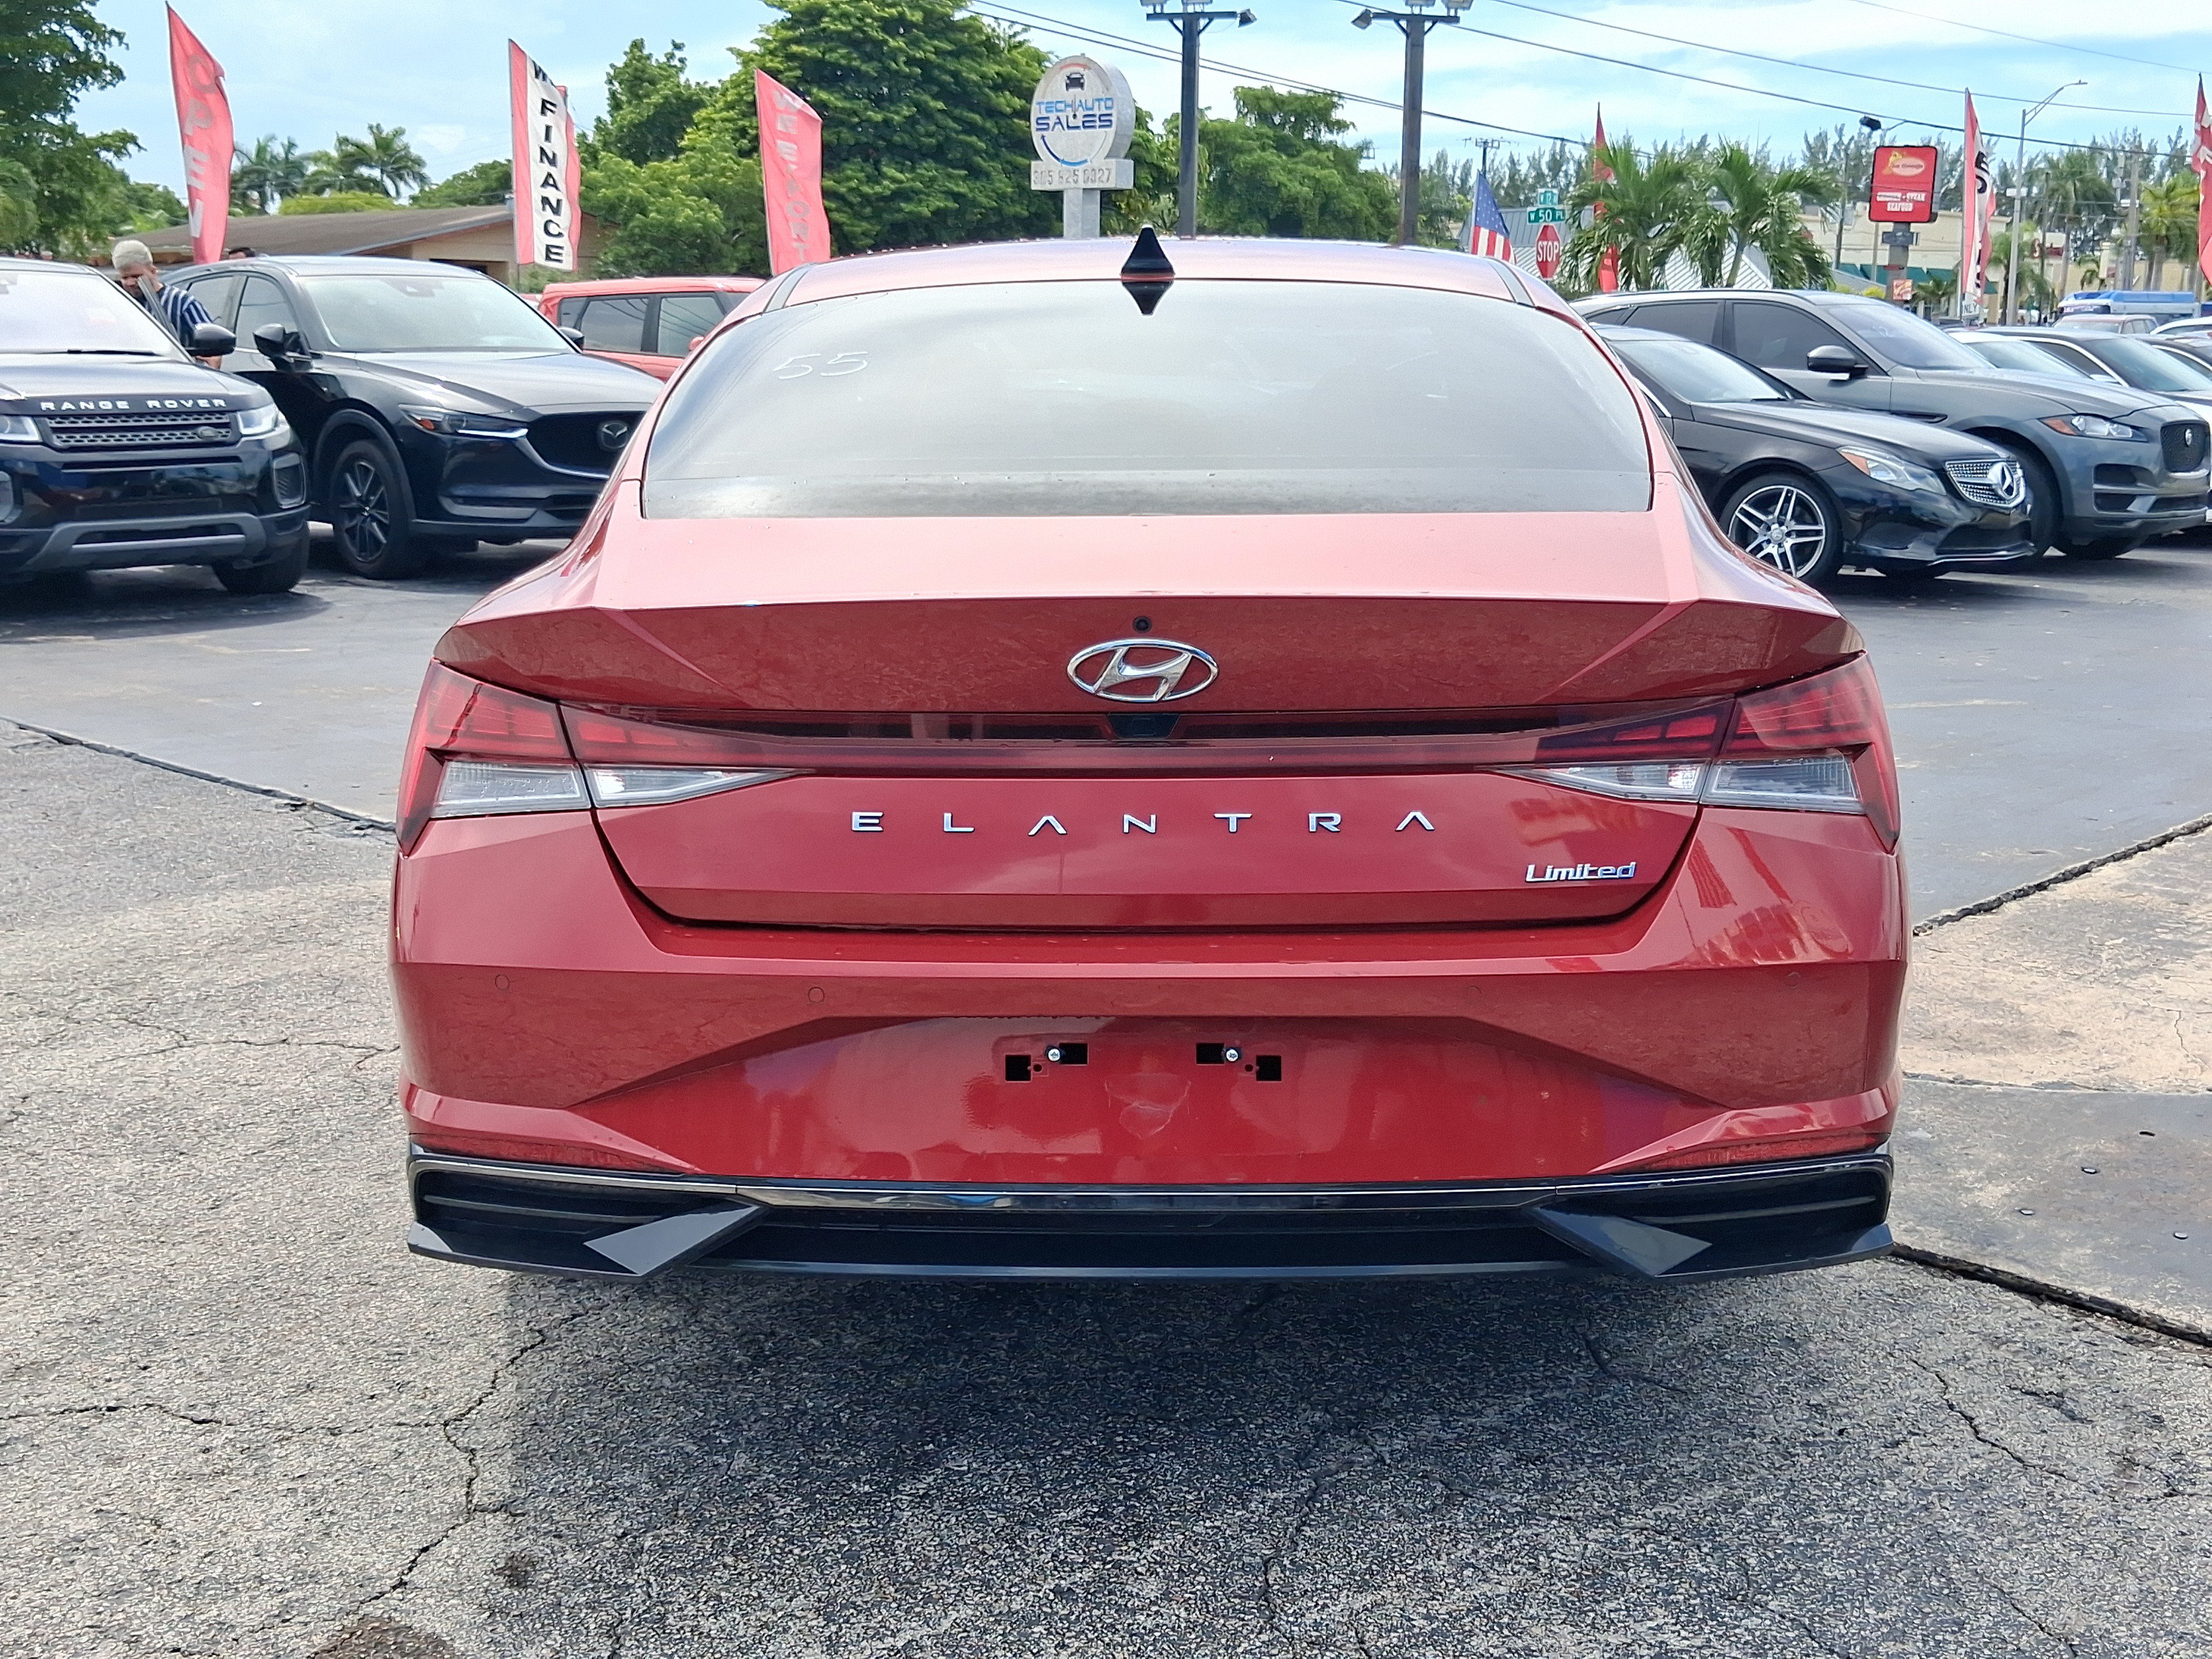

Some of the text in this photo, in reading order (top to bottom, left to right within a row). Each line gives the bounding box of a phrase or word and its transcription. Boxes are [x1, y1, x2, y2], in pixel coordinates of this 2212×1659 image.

[1036, 97, 1114, 114] TECH AUTO
[1036, 113, 1113, 132] SALES
[539, 98, 564, 264] FINANCE
[776, 139, 810, 261] EPORT
[1529, 209, 1565, 222] W 50 PL
[1538, 241, 1560, 262] STOP
[41, 398, 227, 411] RANGE ROVER
[851, 811, 1436, 836] ELANTRA
[1526, 861, 1637, 883] Limited
